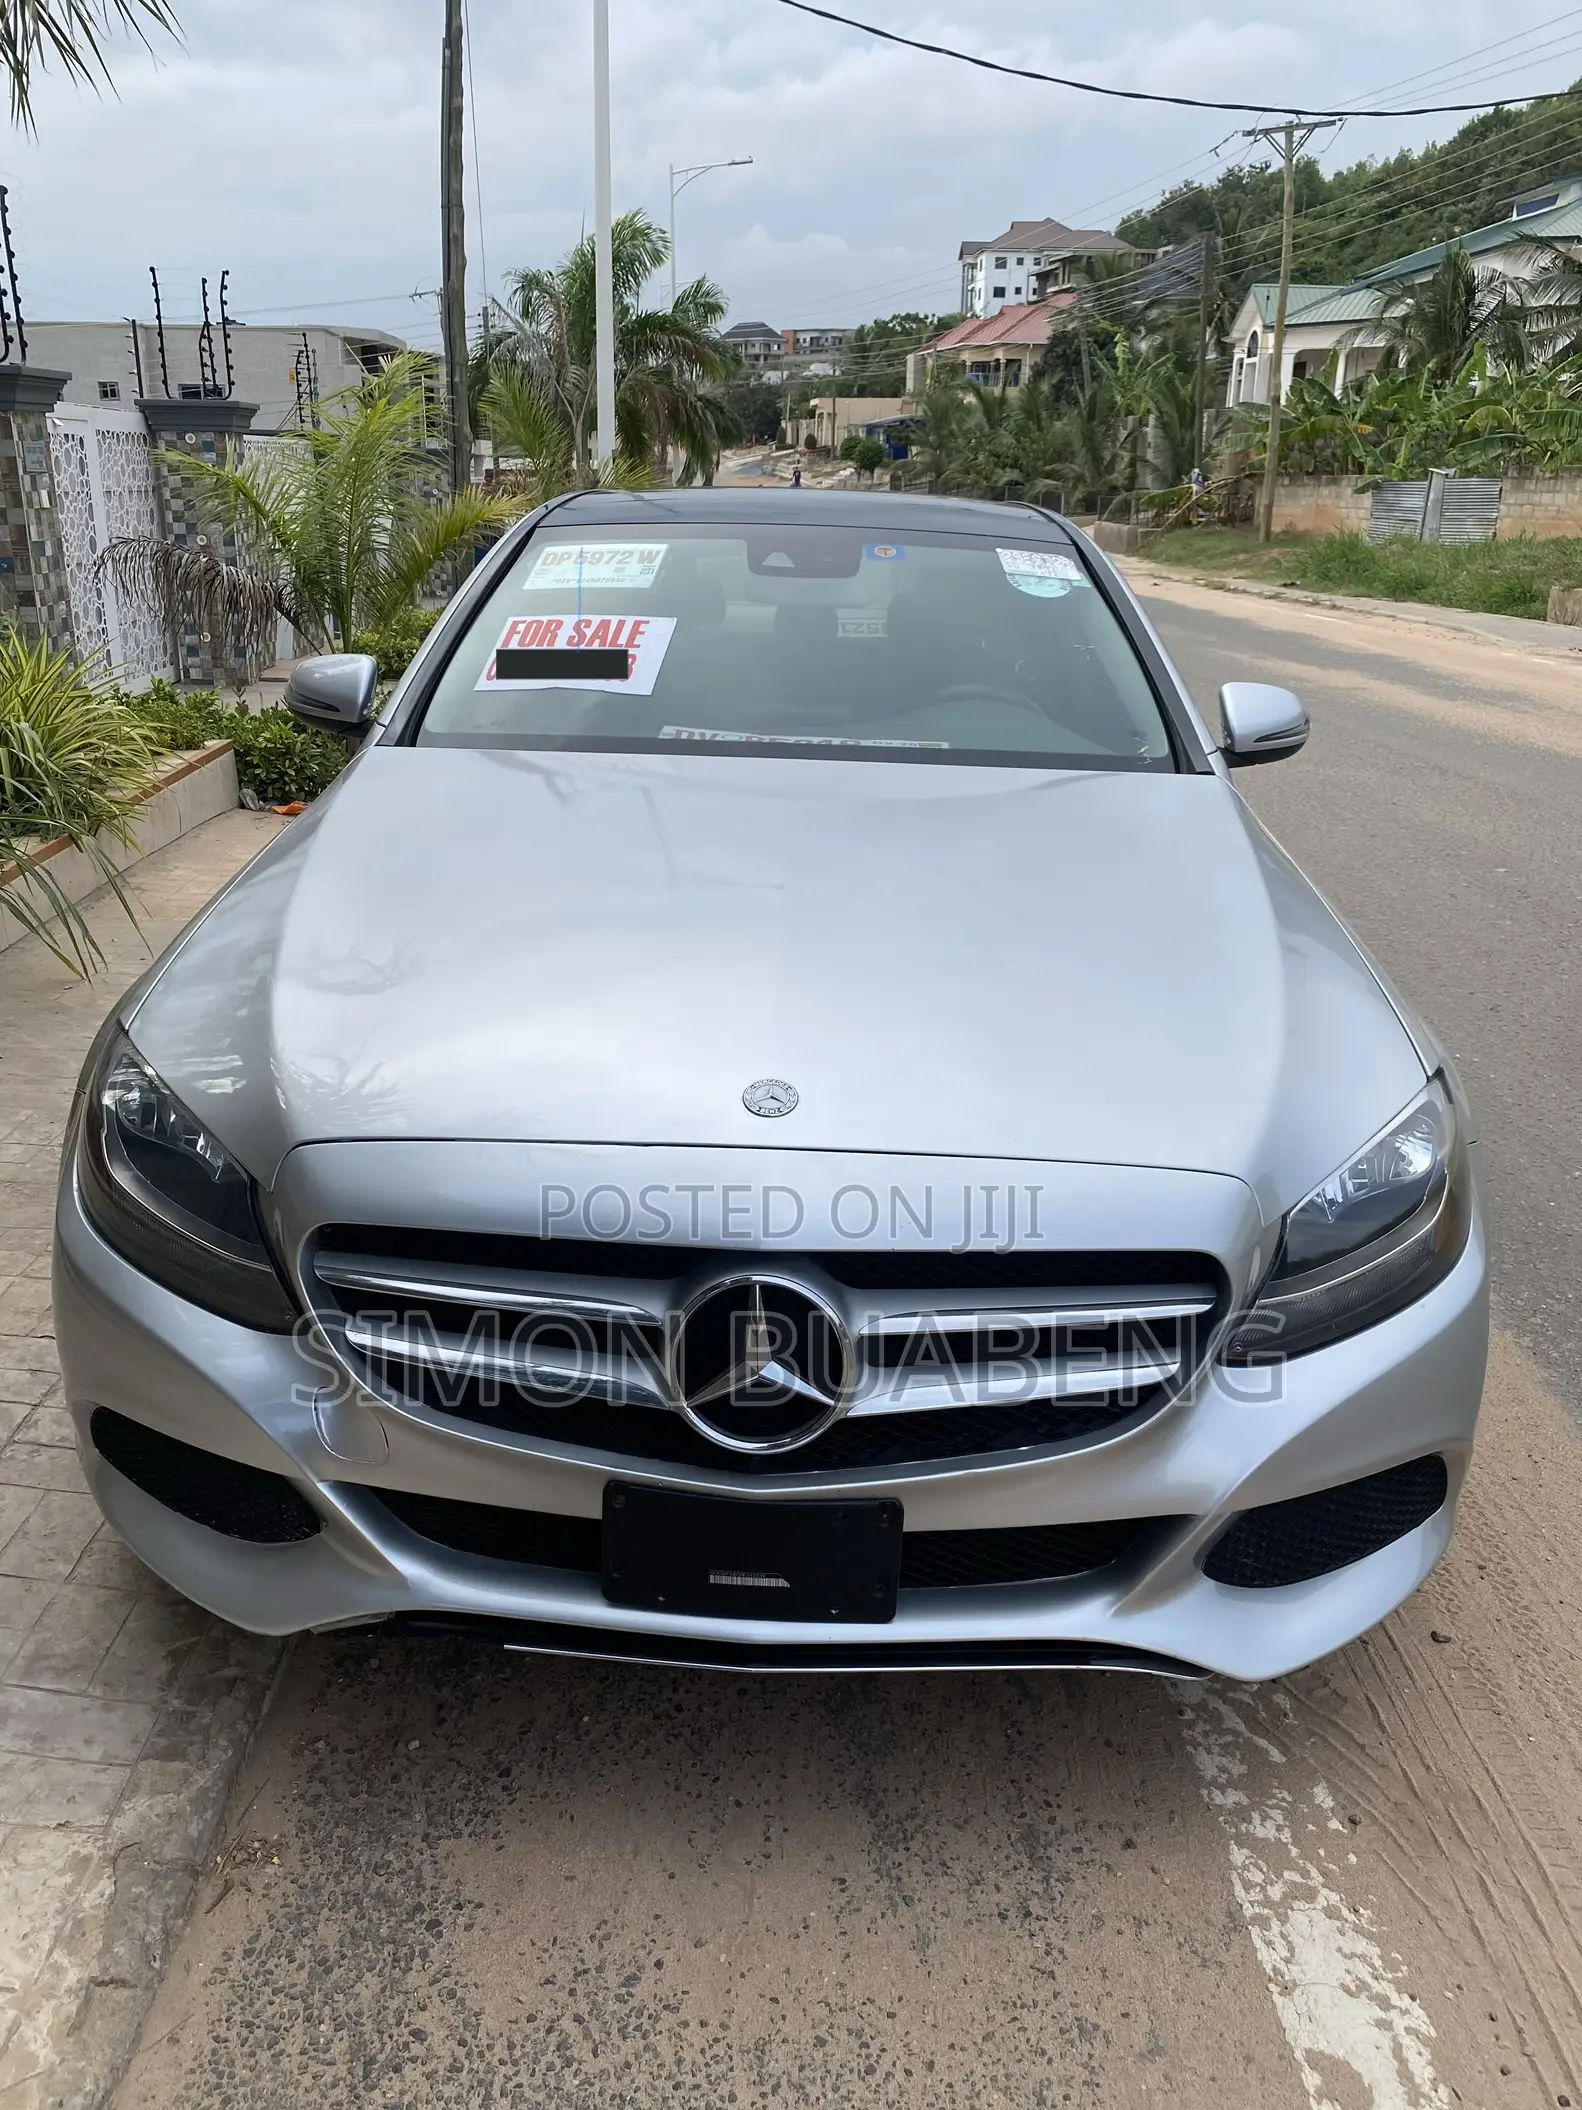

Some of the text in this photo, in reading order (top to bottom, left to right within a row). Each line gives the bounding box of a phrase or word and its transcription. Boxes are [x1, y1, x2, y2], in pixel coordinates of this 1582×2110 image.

[541, 552, 573, 566] DP
[638, 551, 661, 565] W
[501, 619, 650, 648] FOR SALE
